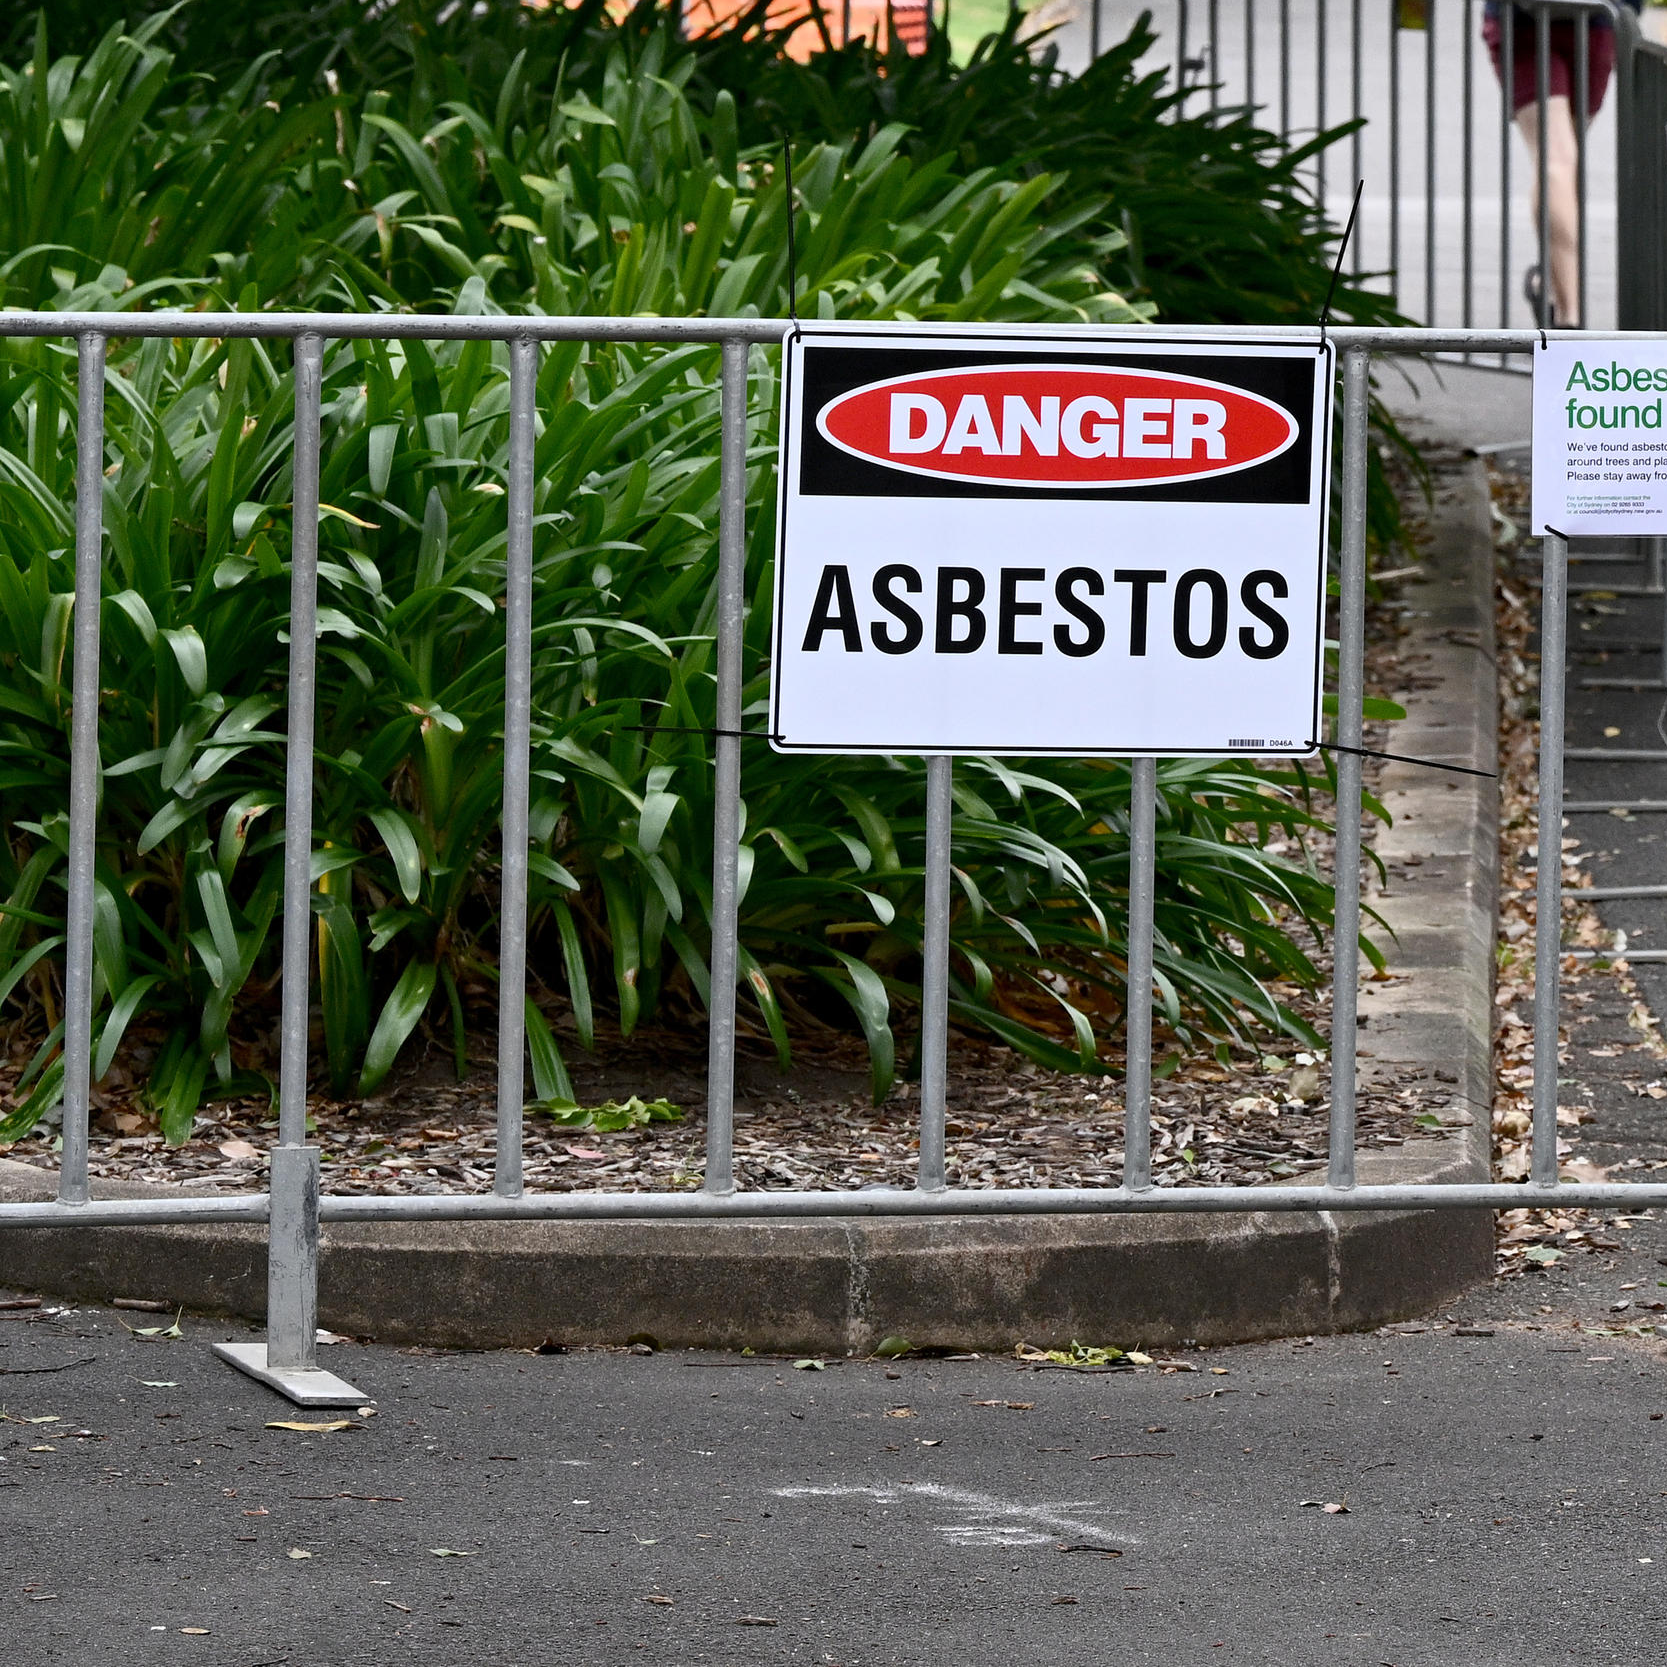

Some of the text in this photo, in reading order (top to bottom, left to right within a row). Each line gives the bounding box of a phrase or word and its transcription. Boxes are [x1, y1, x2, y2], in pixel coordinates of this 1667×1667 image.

[1565, 397, 1663, 429] found
[888, 393, 1228, 460] DANGER
[1567, 442, 1598, 452] We've
[1600, 442, 1629, 452] found
[1567, 457, 1603, 467] around
[1605, 457, 1630, 467] trees
[1632, 457, 1651, 466] and
[1567, 471, 1601, 481] Please
[1603, 471, 1623, 482] stay
[1626, 471, 1652, 482] away
[801, 563, 1289, 660] ASBESTOS
